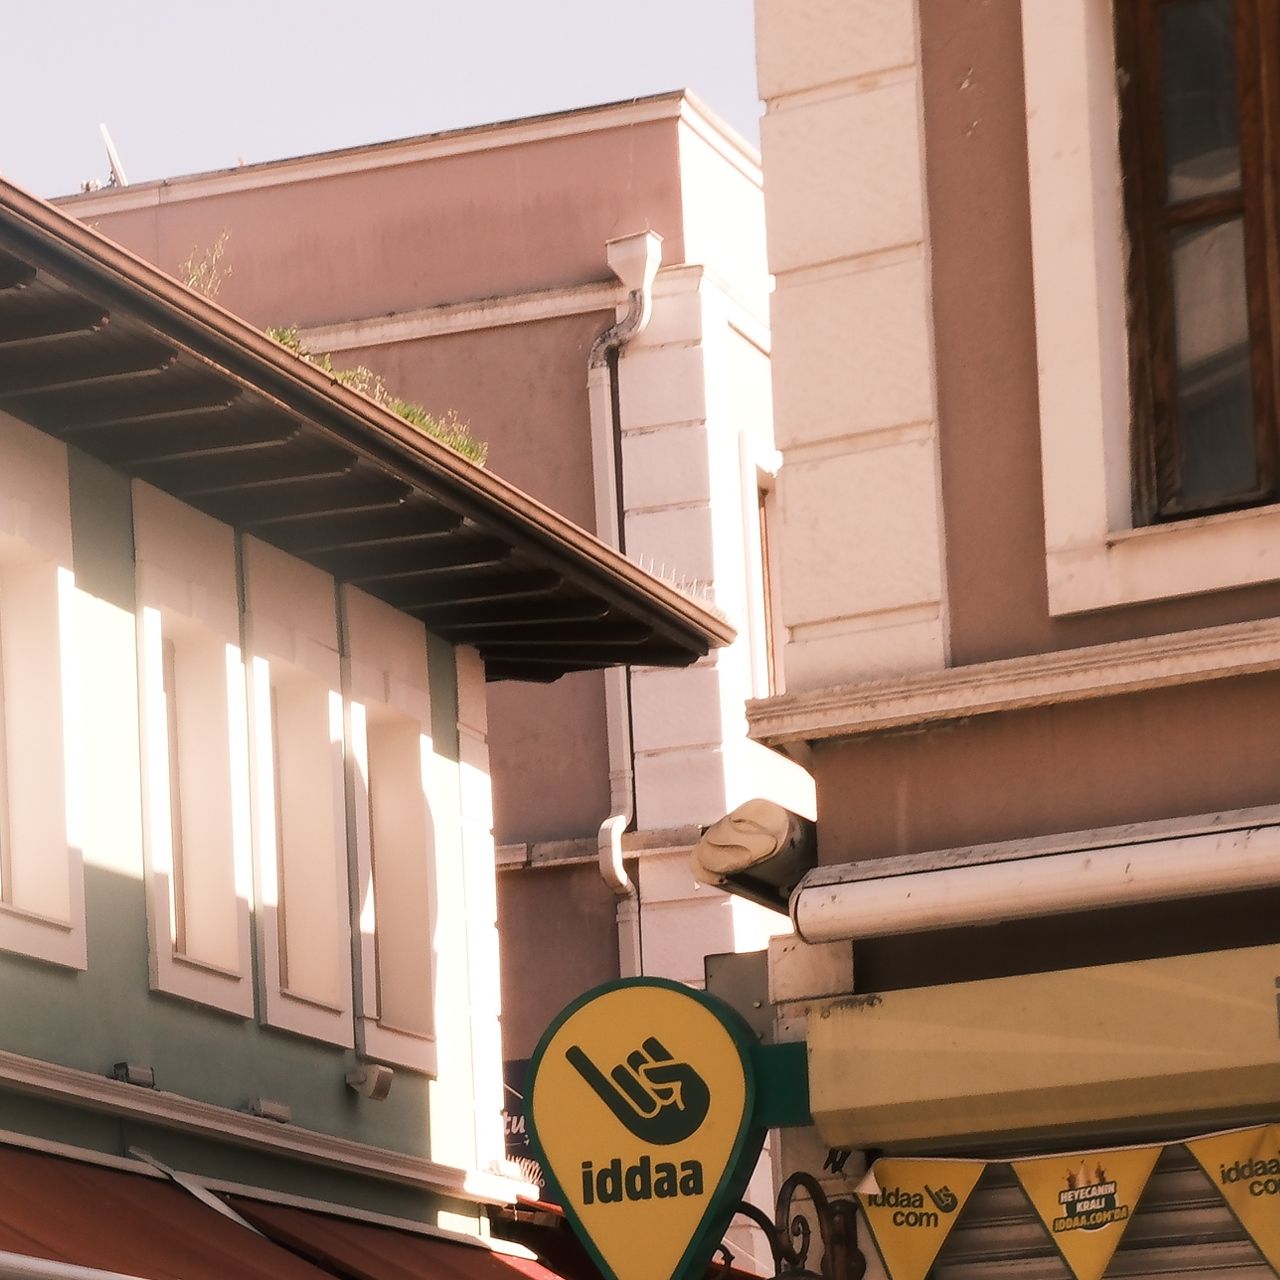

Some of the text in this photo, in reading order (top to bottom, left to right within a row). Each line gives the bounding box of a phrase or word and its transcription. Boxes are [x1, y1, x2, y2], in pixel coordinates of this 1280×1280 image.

[580, 1156, 704, 1205] iddaa
[1249, 1178, 1280, 1196] co
[893, 1210, 938, 1227] com
